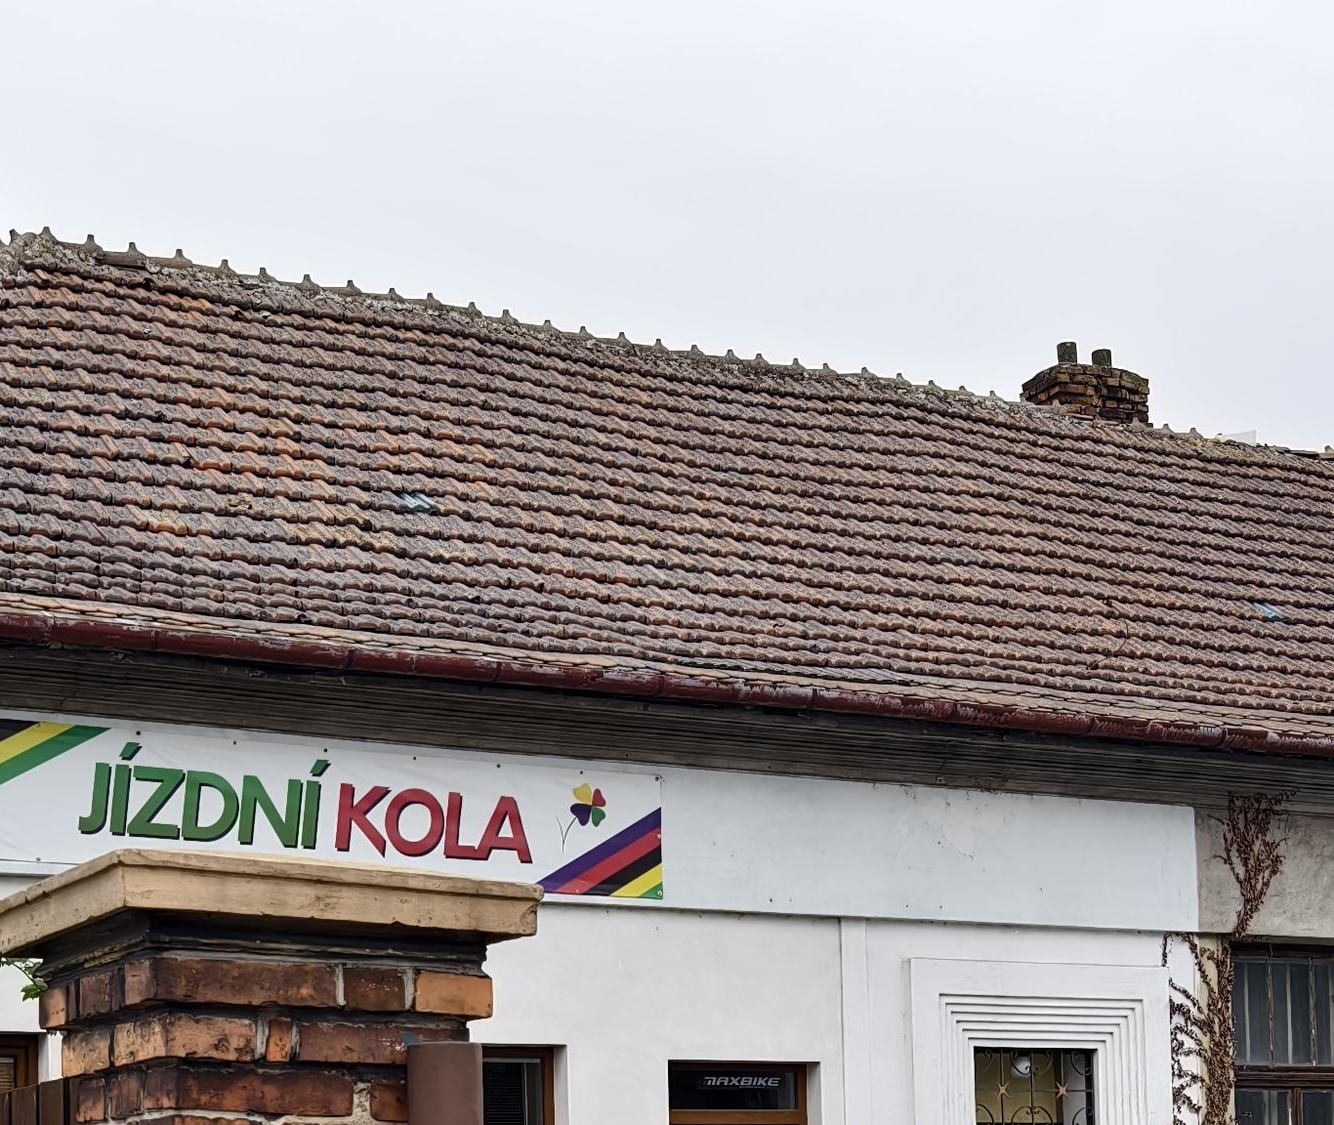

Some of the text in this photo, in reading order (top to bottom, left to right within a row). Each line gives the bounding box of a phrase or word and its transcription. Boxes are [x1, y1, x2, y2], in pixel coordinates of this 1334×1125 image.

[78, 742, 533, 864] JÍZDNÍ KOLA
[702, 1076, 781, 1087] MAXBIKE
